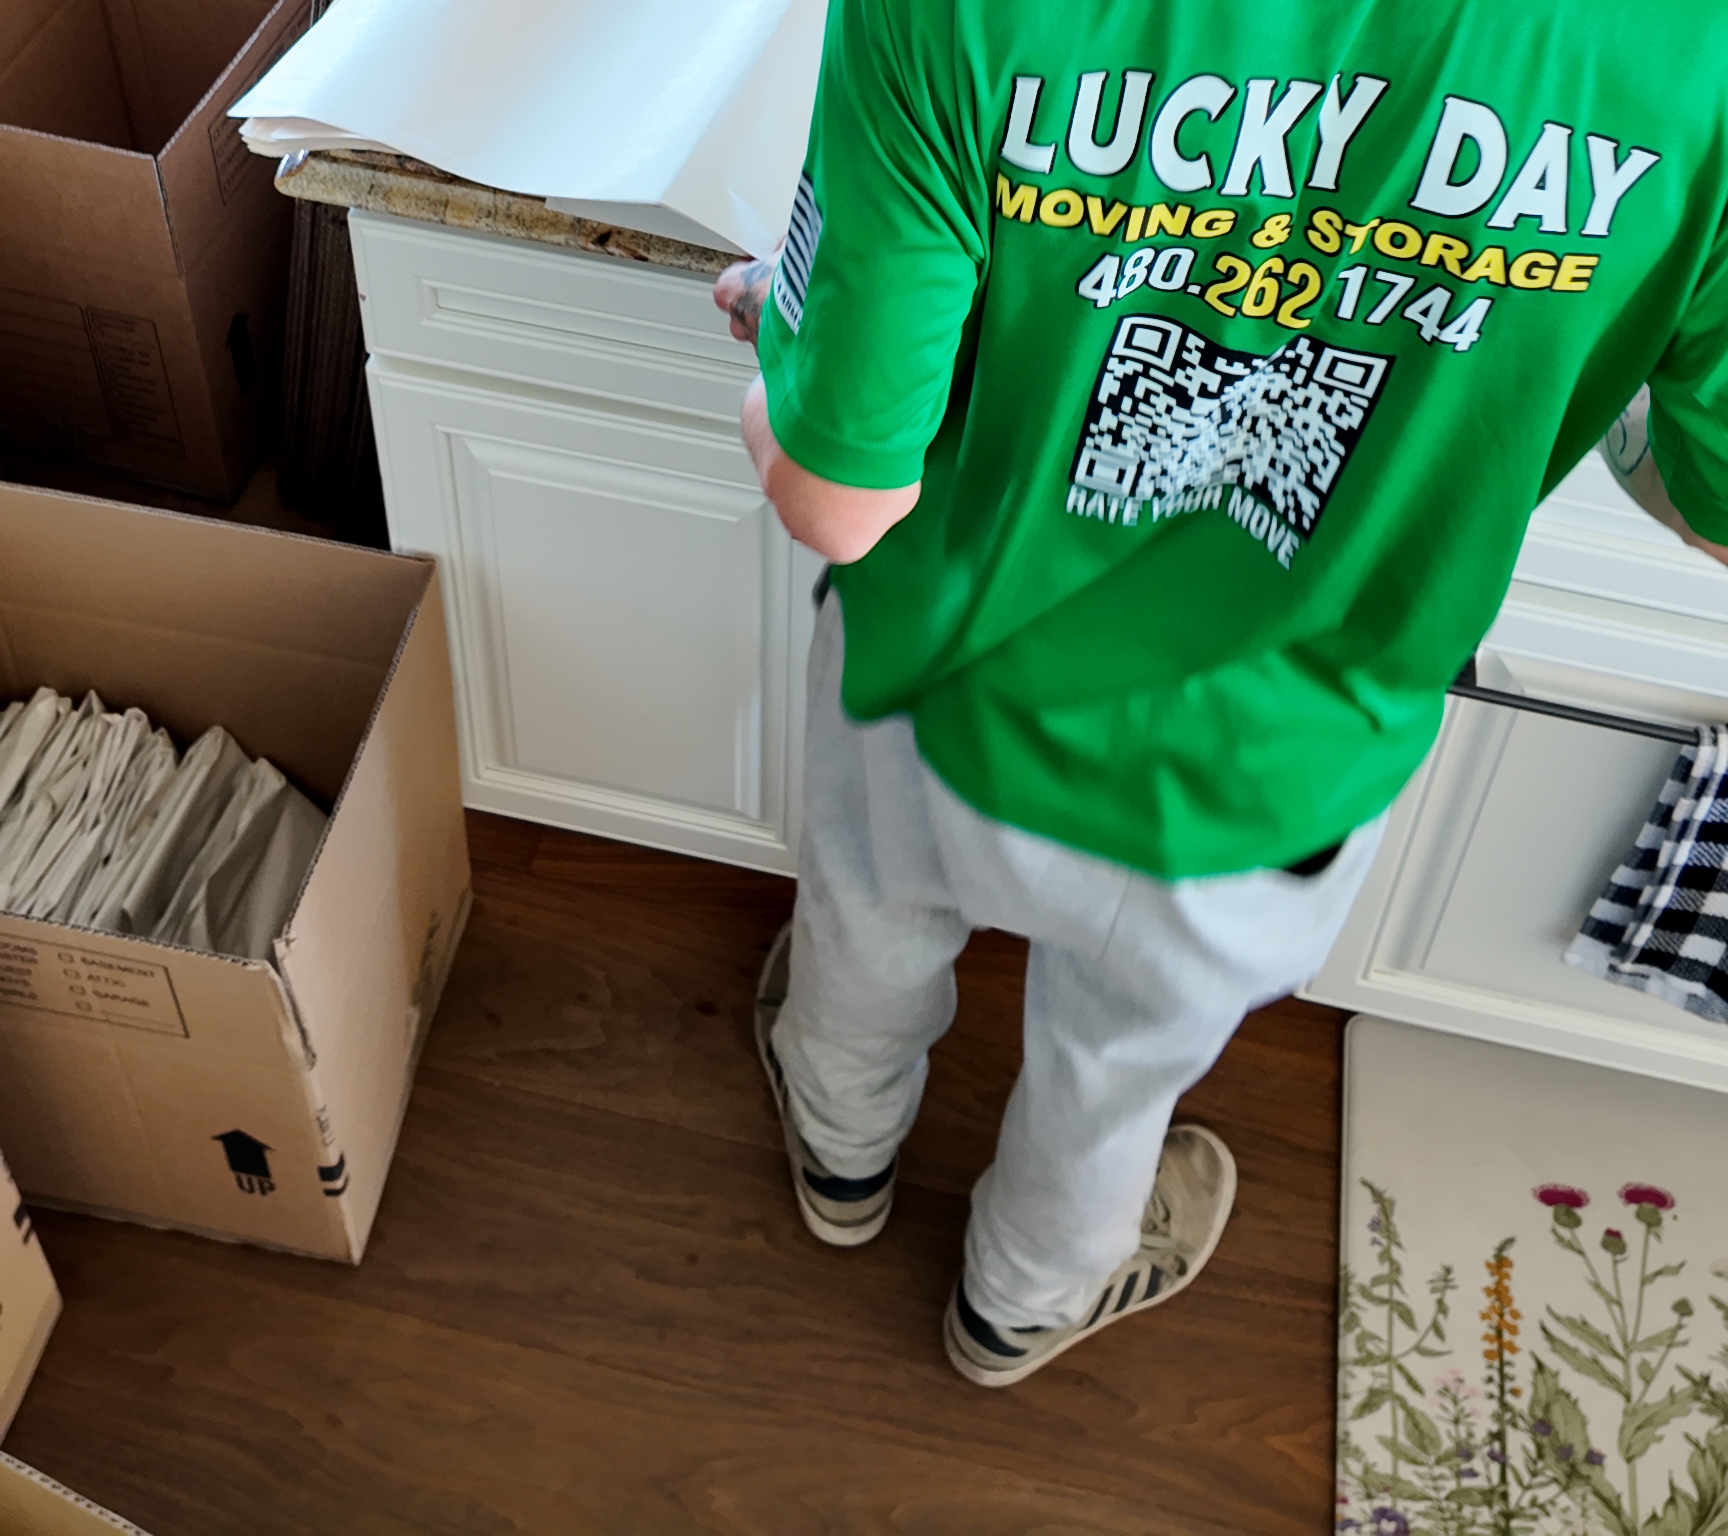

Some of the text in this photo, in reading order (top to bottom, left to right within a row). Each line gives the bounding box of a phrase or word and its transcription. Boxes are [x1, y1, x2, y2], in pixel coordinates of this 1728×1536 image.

[1000, 70, 1661, 237] LUCKY DAY
[996, 172, 1600, 292] MOVING & STORAGE
[1227, 484, 1299, 571] MOVE
[236, 1173, 277, 1197] UP
